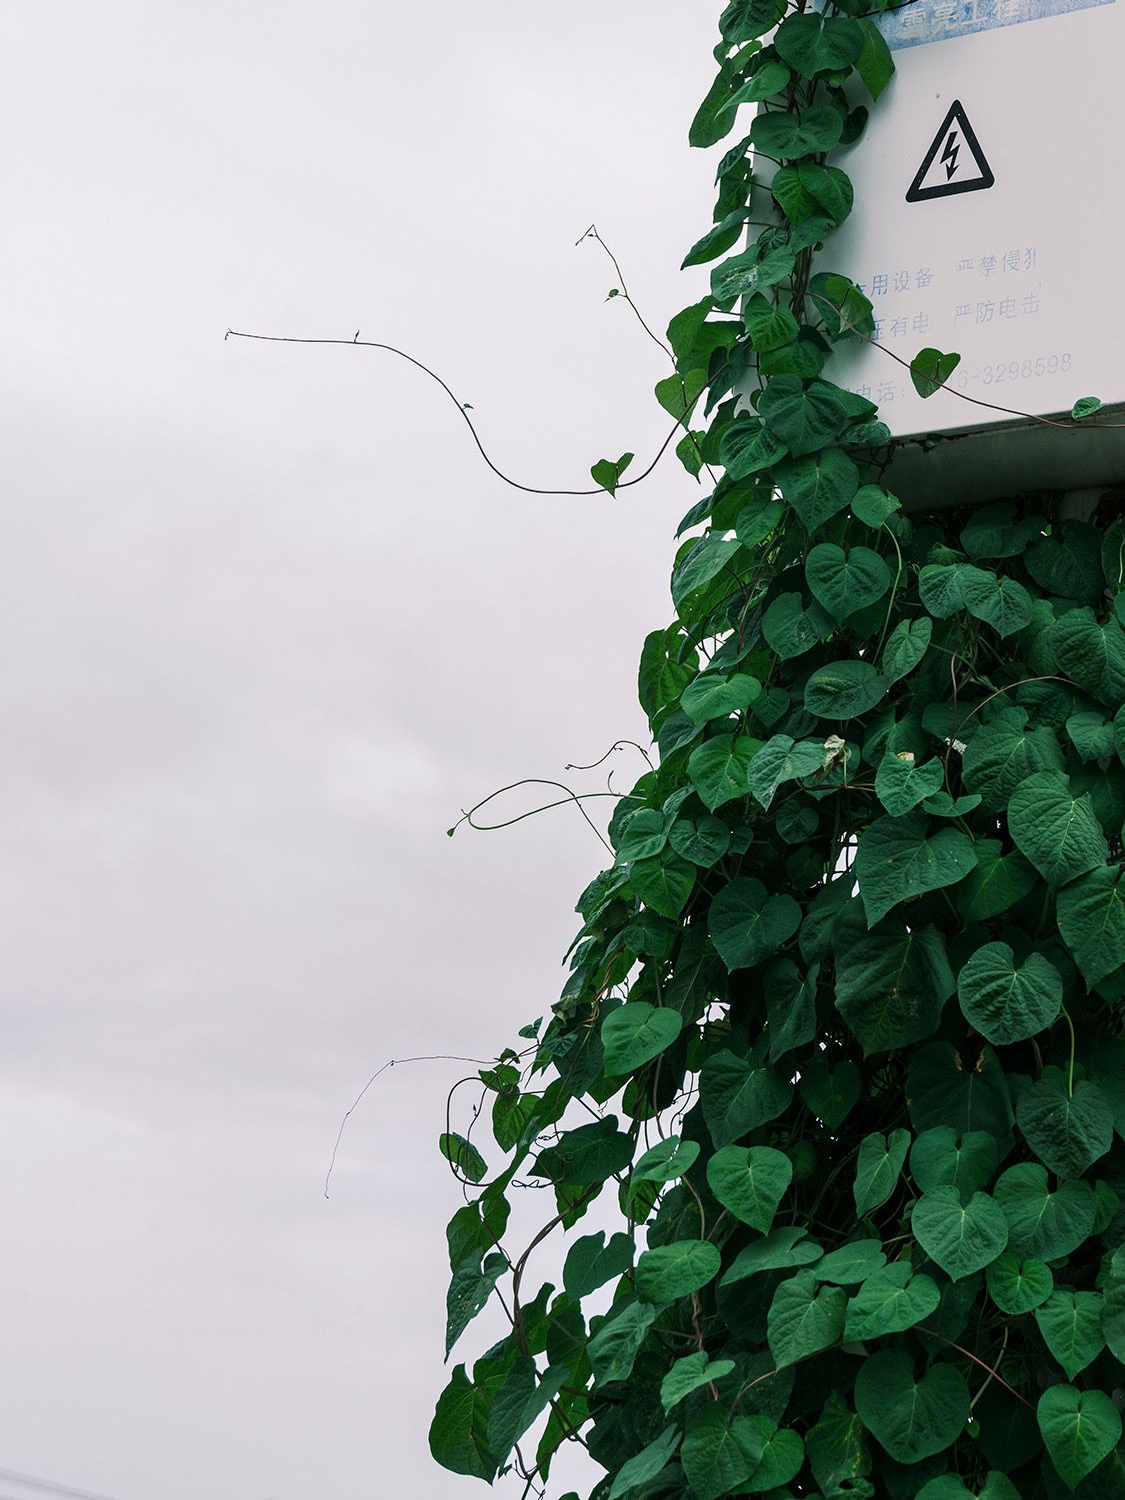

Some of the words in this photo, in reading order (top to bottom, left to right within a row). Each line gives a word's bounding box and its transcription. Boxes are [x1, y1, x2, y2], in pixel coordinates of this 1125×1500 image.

[858, 268, 934, 297] 用设备
[848, 311, 930, 343] 压有电
[954, 292, 1041, 327] 严防电击
[948, 353, 1072, 389] 6-3298598
